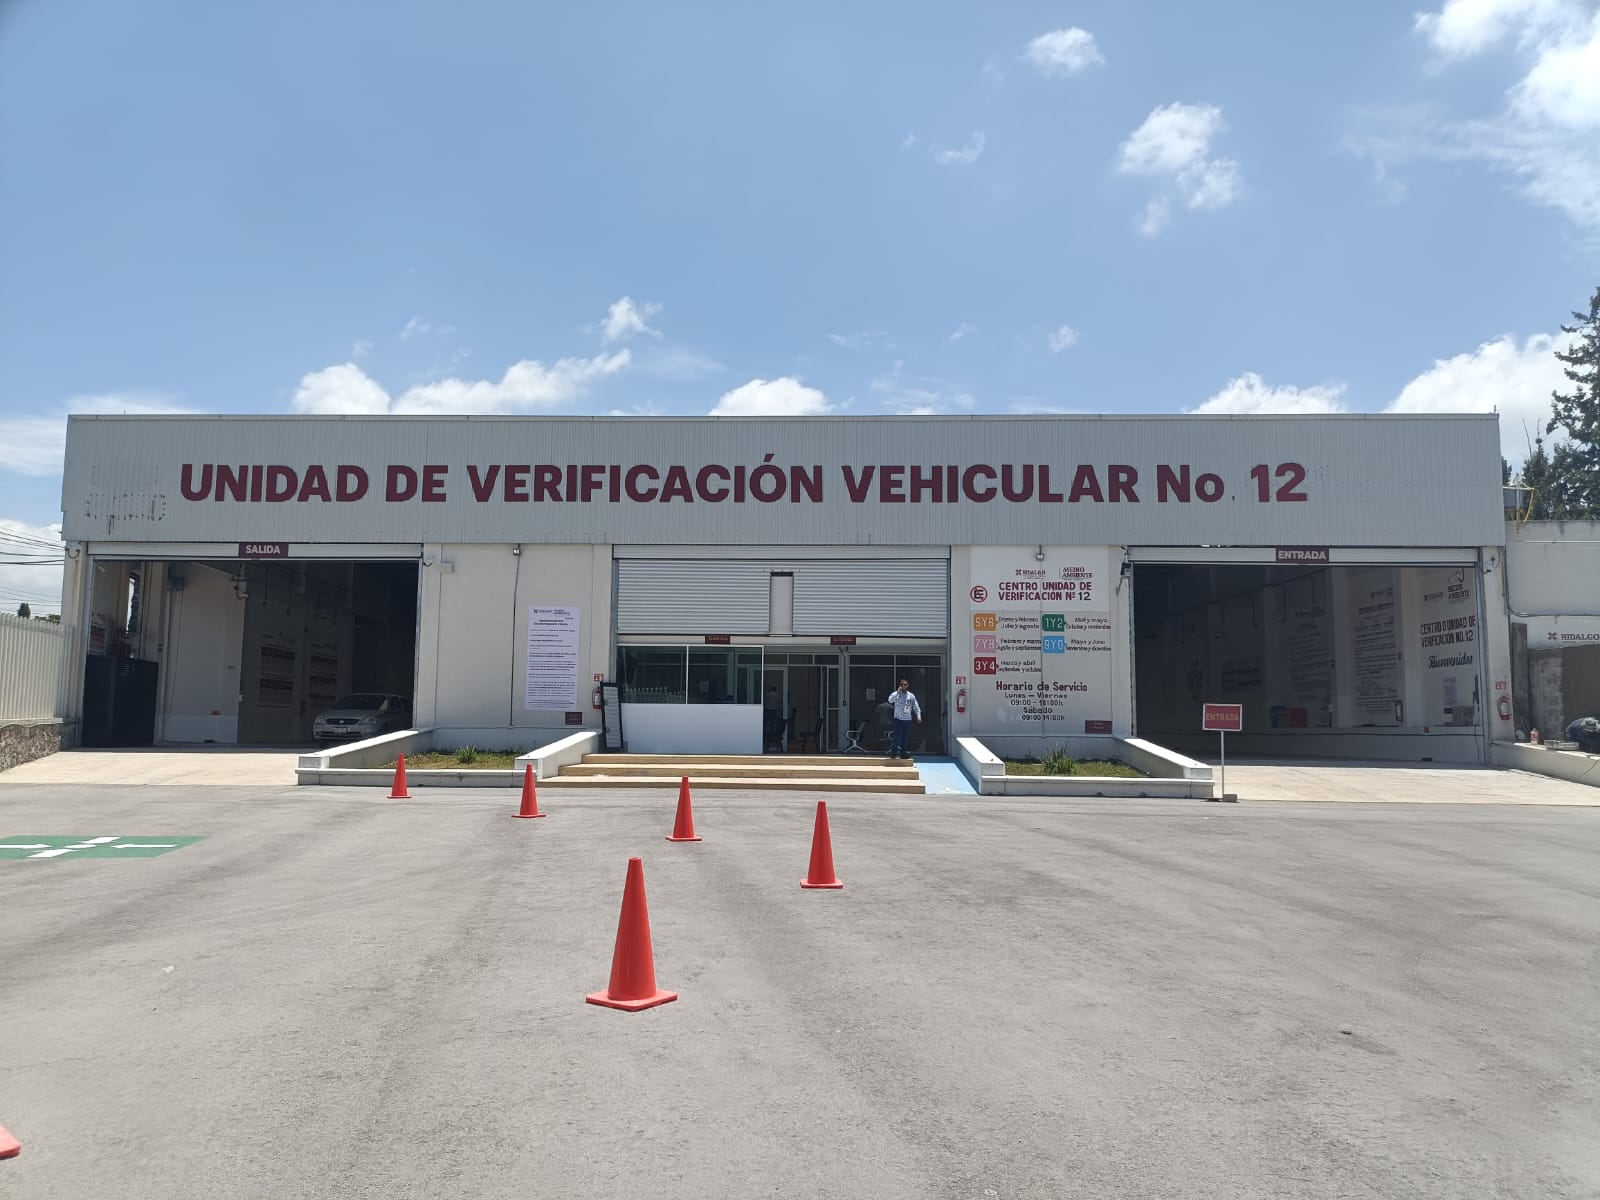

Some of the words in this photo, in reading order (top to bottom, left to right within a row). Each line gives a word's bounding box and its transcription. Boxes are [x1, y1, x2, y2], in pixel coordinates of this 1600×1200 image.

[180, 464, 369, 502] UNIDAD
[385, 465, 448, 502] DE
[467, 453, 824, 503] VERIFICACIÓN
[841, 464, 1140, 502] VEHICULAR
[1250, 462, 1308, 502] 12
[245, 545, 281, 554] SALIDA
[1277, 551, 1328, 560] ENTRADA
[998, 582, 1038, 591] CENTRO
[1042, 582, 1076, 591] UNIDAD
[1079, 582, 1092, 591] DE
[1077, 592, 1092, 601] 12
[1420, 621, 1441, 635] CENTRO
[1447, 617, 1467, 630] UNIDAD
[1469, 615, 1476, 627] DE
[1466, 630, 1474, 642] 12
[1560, 633, 1600, 641] HIDALGO
[1428, 652, 1473, 669] Bienvenidos
[995, 681, 1033, 691] Horario
[1037, 681, 1050, 691] de
[1053, 682, 1088, 692] Servicio
[1023, 705, 1053, 714] Sábado
[1206, 713, 1240, 721] ENTRADA
